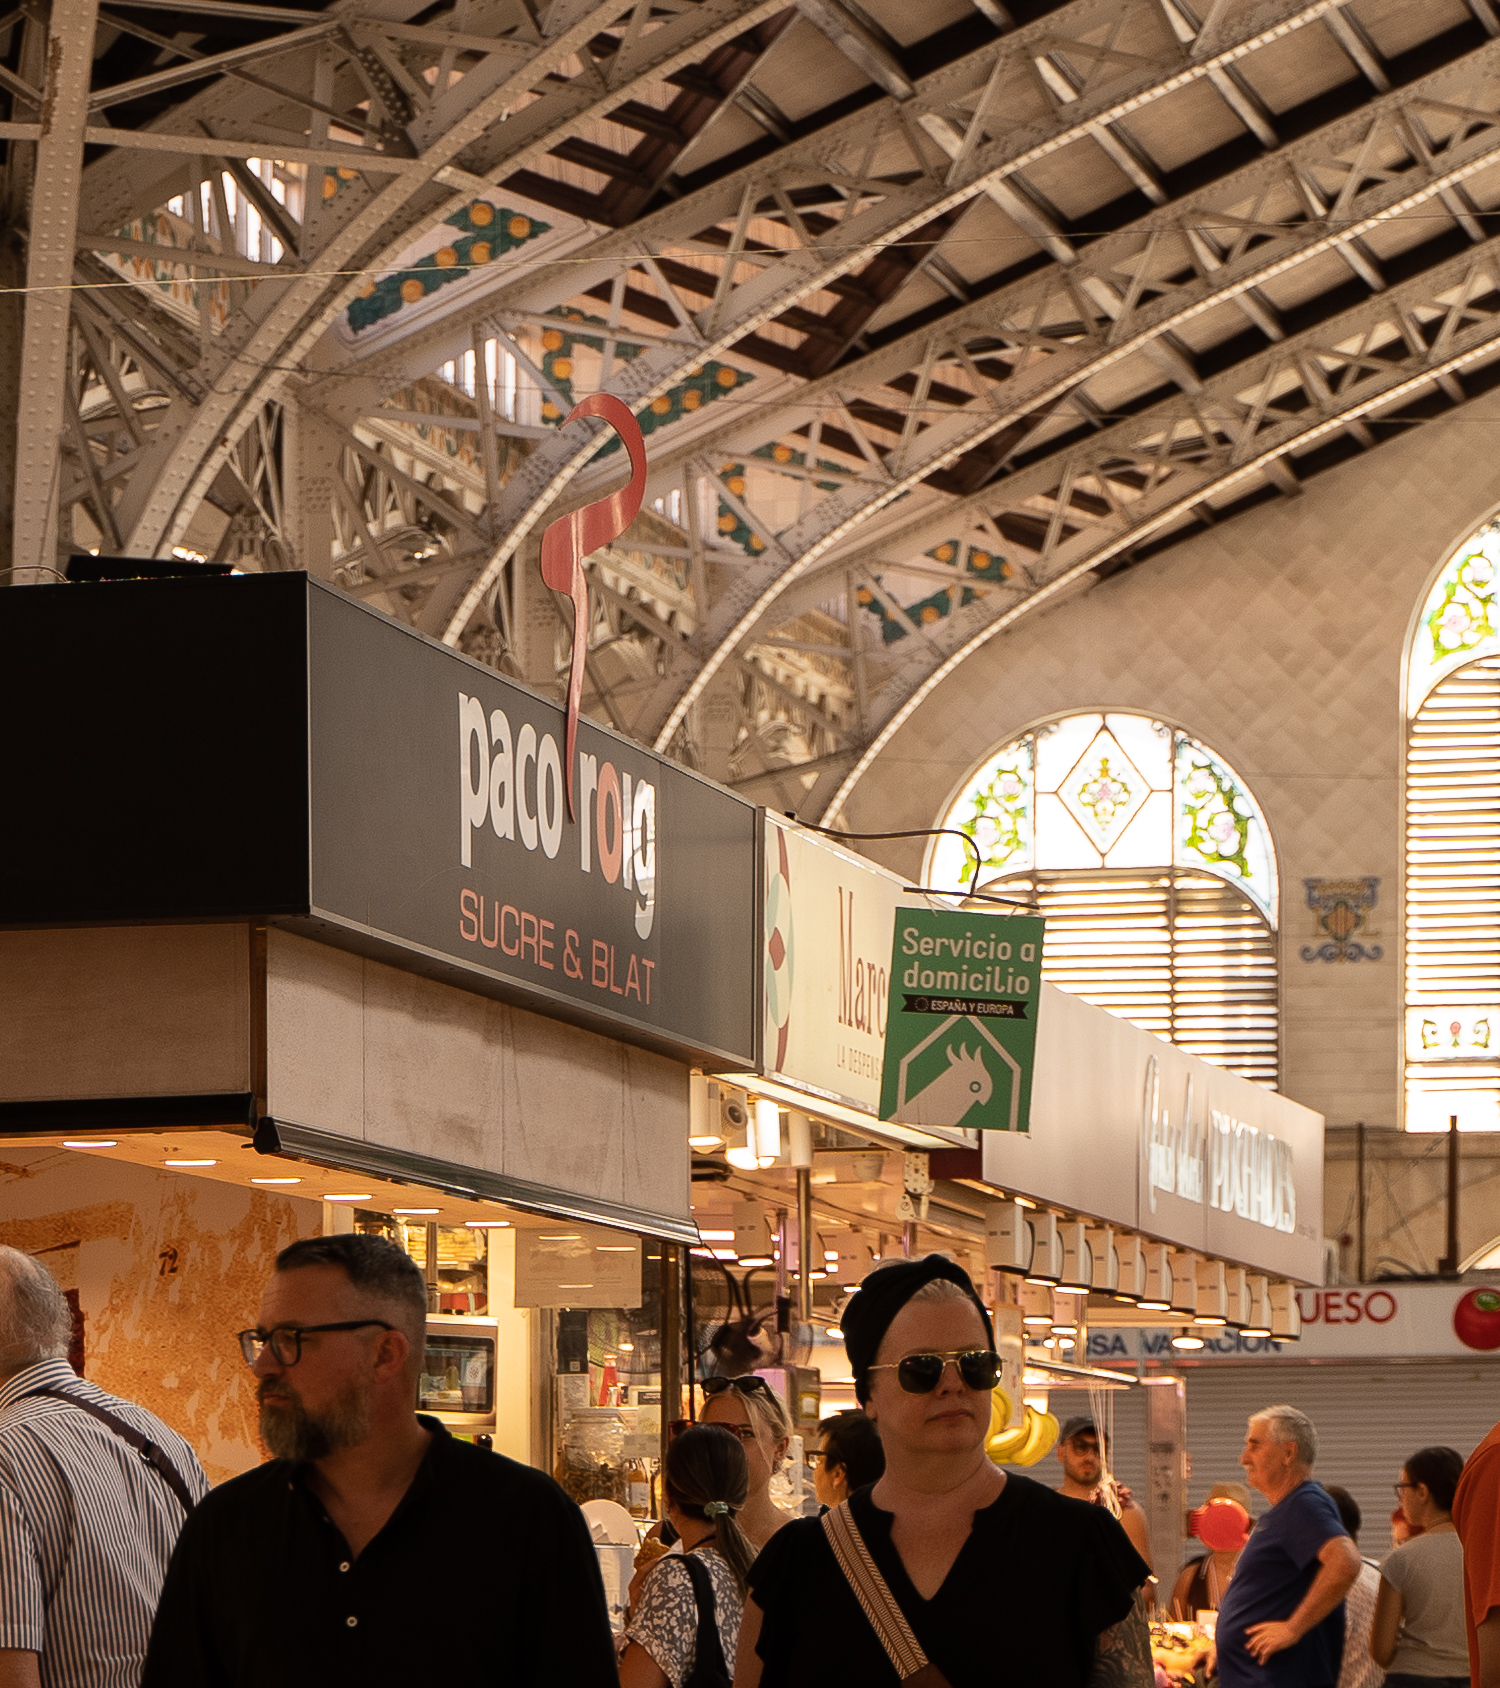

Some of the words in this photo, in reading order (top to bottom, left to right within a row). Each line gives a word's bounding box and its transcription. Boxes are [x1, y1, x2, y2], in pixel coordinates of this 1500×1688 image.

[458, 692, 564, 869] paco
[459, 887, 556, 971] SUCRE
[562, 928, 584, 981] &
[591, 938, 656, 1005] BLAT
[902, 927, 1012, 962] Servicio
[1020, 942, 1036, 963] a
[903, 961, 1031, 996] domicilio
[930, 999, 968, 1013] ESPAÑA
[976, 1003, 1015, 1016] EUROPA
[1295, 1290, 1397, 1324] UESO
